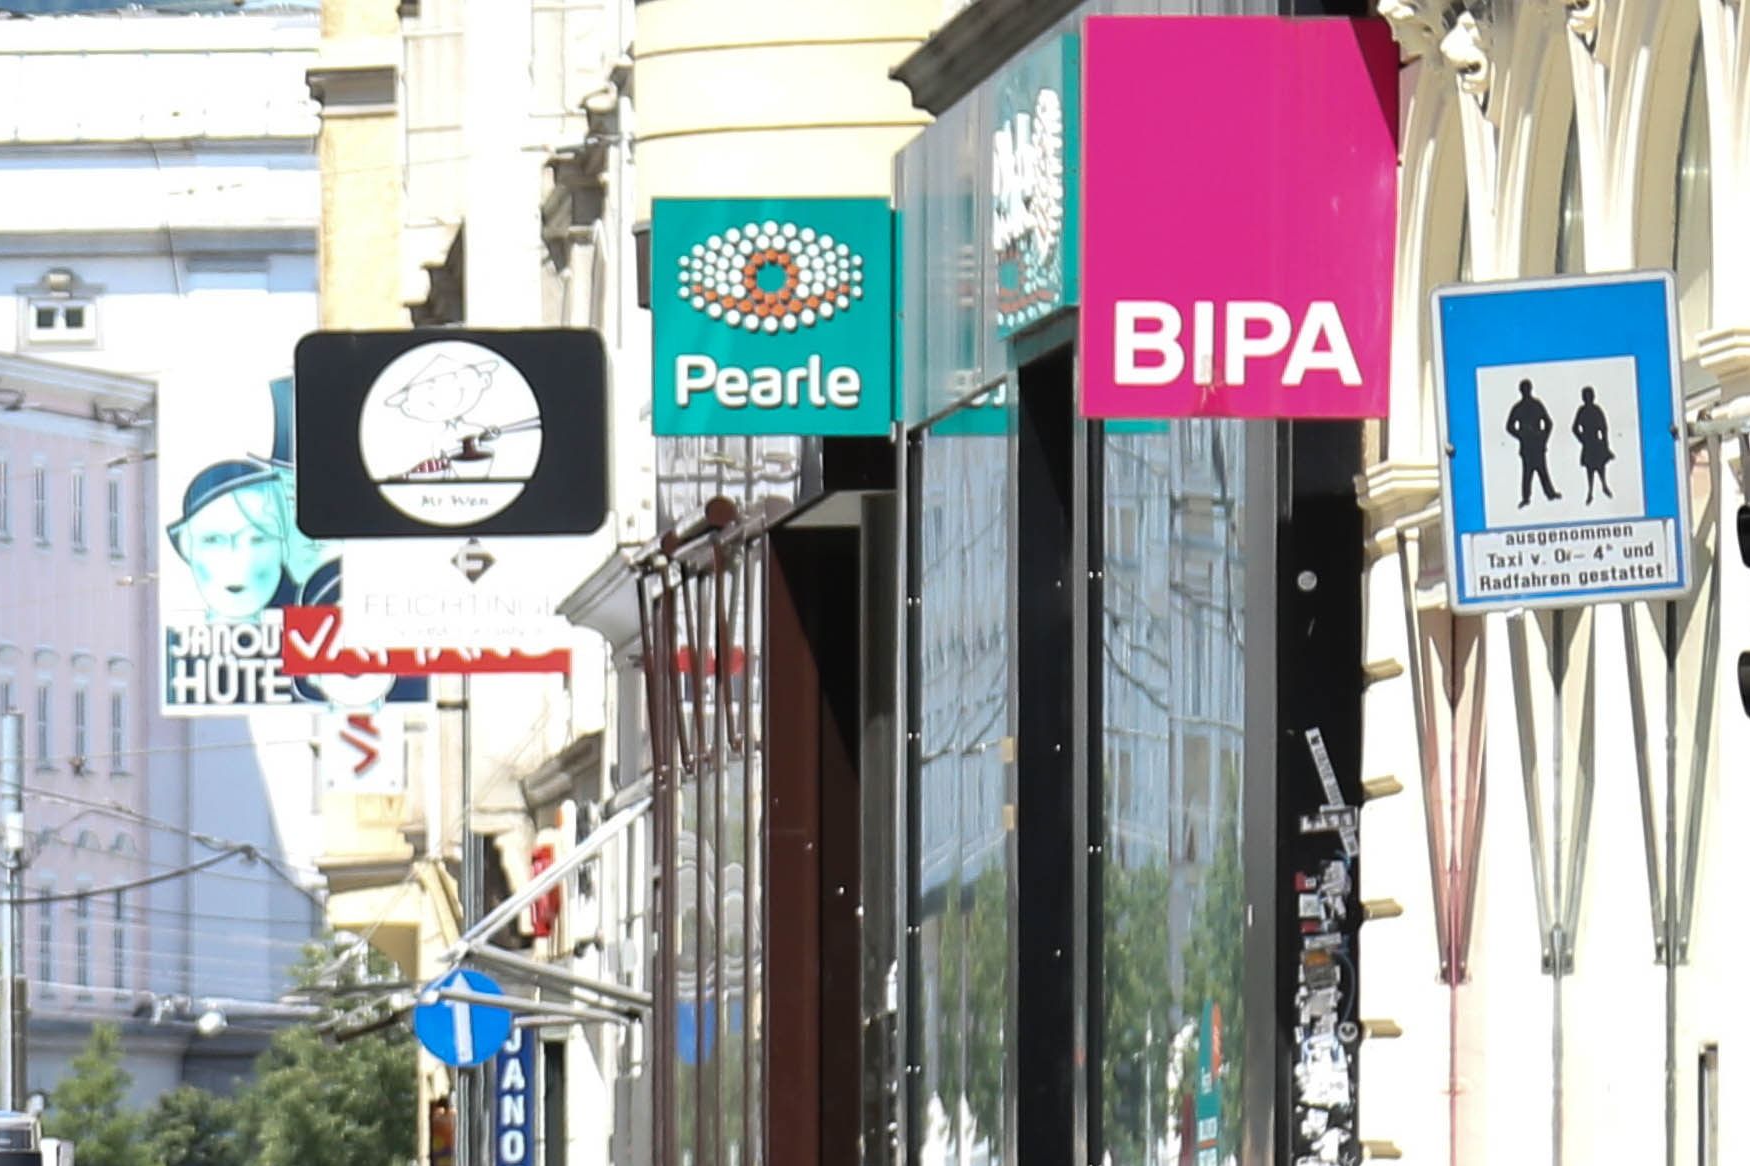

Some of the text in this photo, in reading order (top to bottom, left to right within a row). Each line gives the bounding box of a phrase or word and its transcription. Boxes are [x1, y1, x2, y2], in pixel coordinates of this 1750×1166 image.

[1113, 300, 1363, 386] BIPA
[675, 354, 862, 409] Pearle
[1505, 524, 1634, 547] ausgenommen
[1487, 552, 1524, 569] Taxi
[1623, 541, 1654, 558] und
[1480, 563, 1663, 592] Radfahren gestattet
